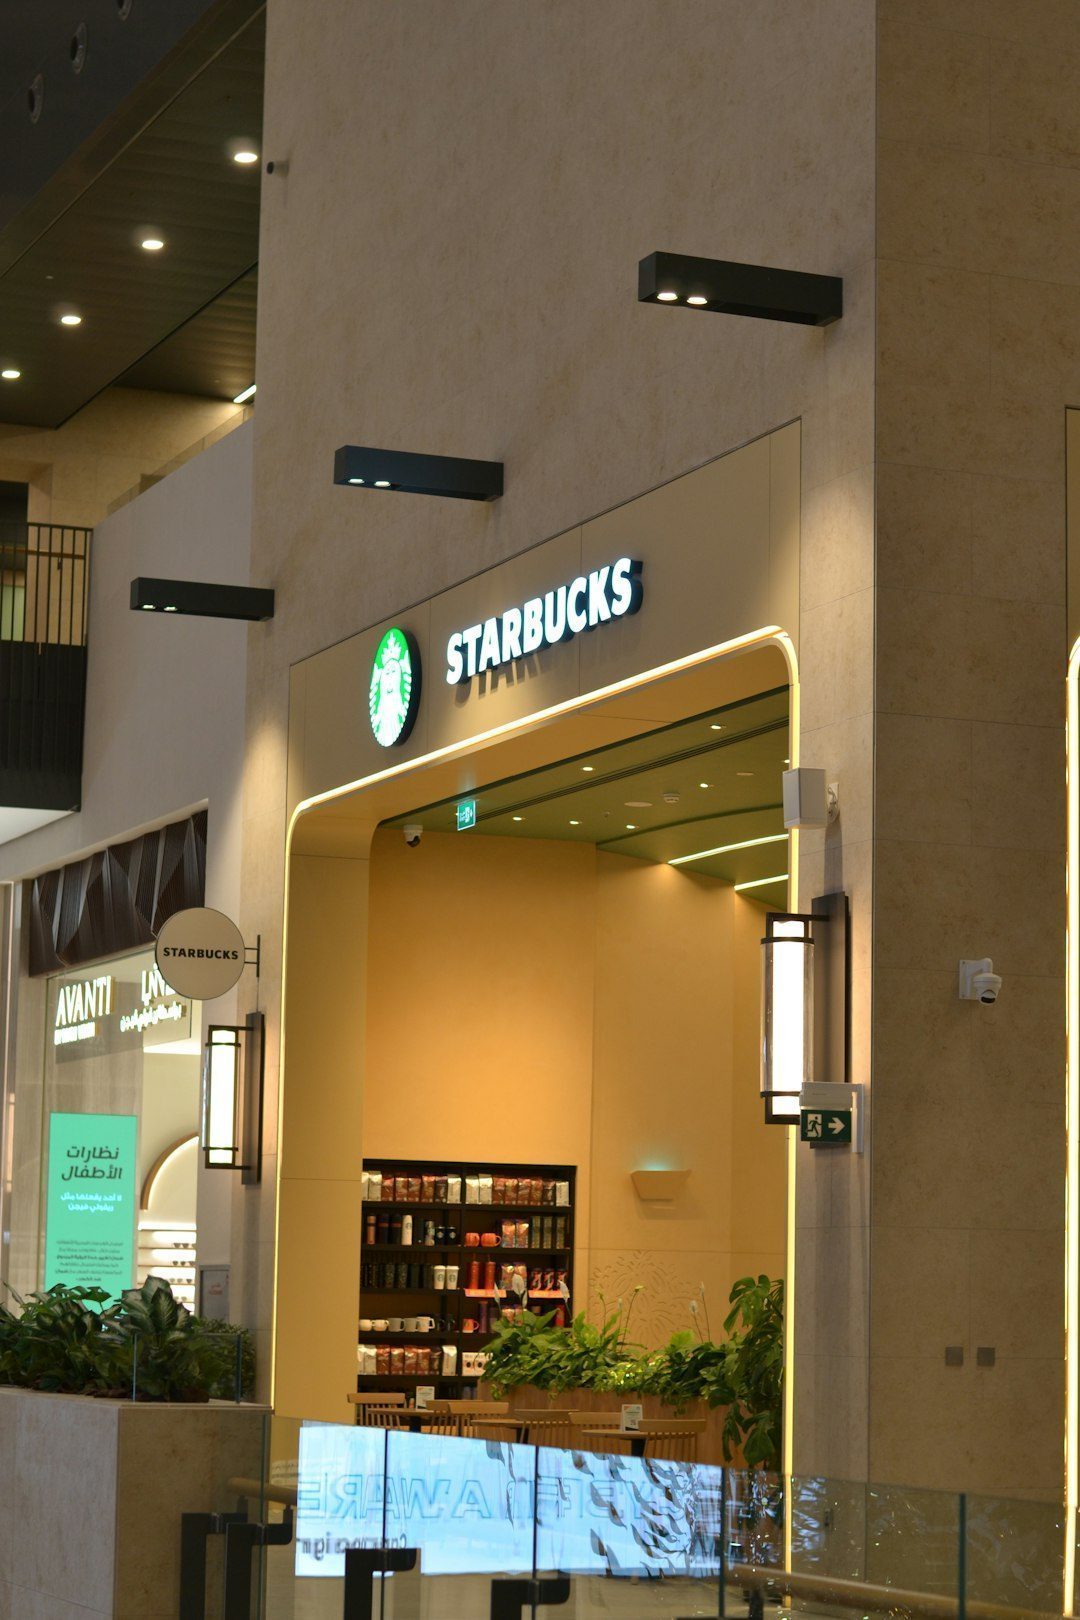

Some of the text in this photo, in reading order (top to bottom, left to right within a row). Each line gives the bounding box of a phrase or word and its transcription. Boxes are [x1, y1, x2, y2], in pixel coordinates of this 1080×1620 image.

[446, 558, 634, 685] STARBUCKS
[162, 946, 239, 961] STARBUCKS
[55, 975, 112, 1027] AVANTI
[66, 1145, 120, 1163] نظارات
[61, 1164, 123, 1181] الأطفال
